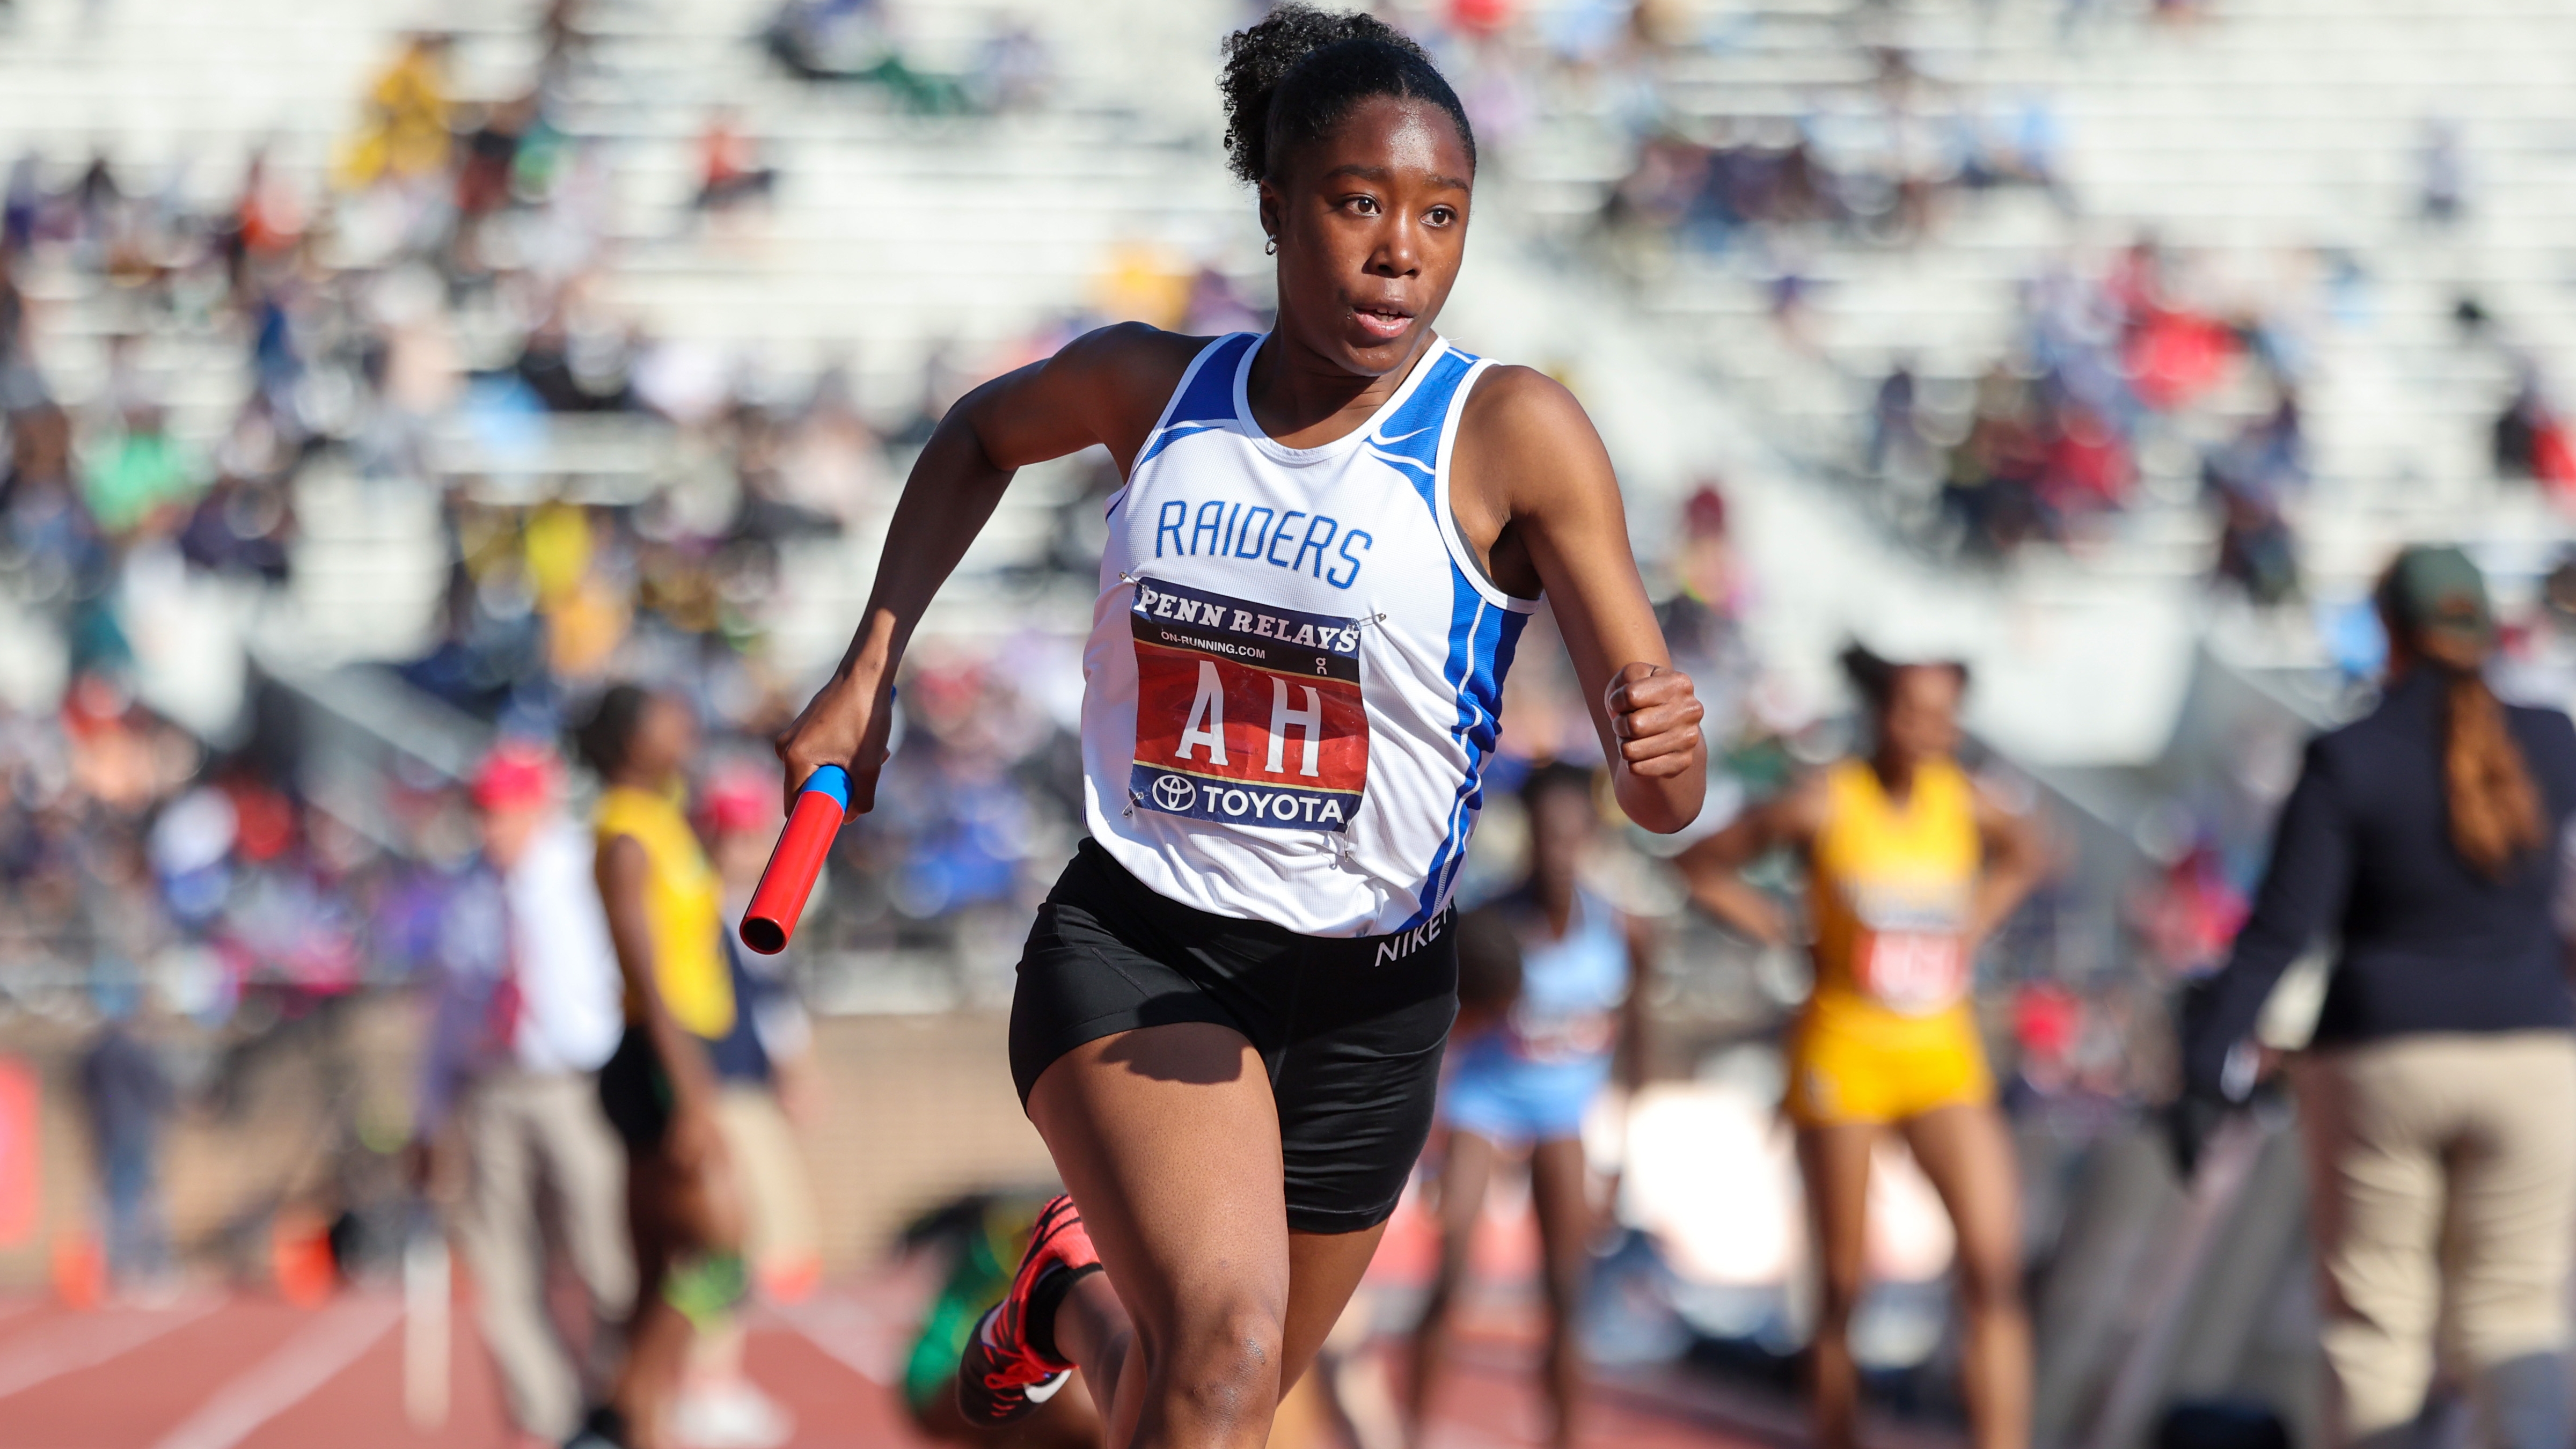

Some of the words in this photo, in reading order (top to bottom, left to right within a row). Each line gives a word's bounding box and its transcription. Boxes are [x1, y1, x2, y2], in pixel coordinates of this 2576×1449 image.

[1156, 500, 1372, 589] RAIDERS
[1133, 590, 1226, 627] PENN
[1230, 609, 1360, 652] RELAYS
[1161, 632, 1265, 659] ON-RUNNING.COM
[1175, 661, 1228, 766] A
[1264, 676, 1322, 777] H
[1203, 786, 1344, 824] TOYOTA
[1374, 918, 1440, 967] NIKE
